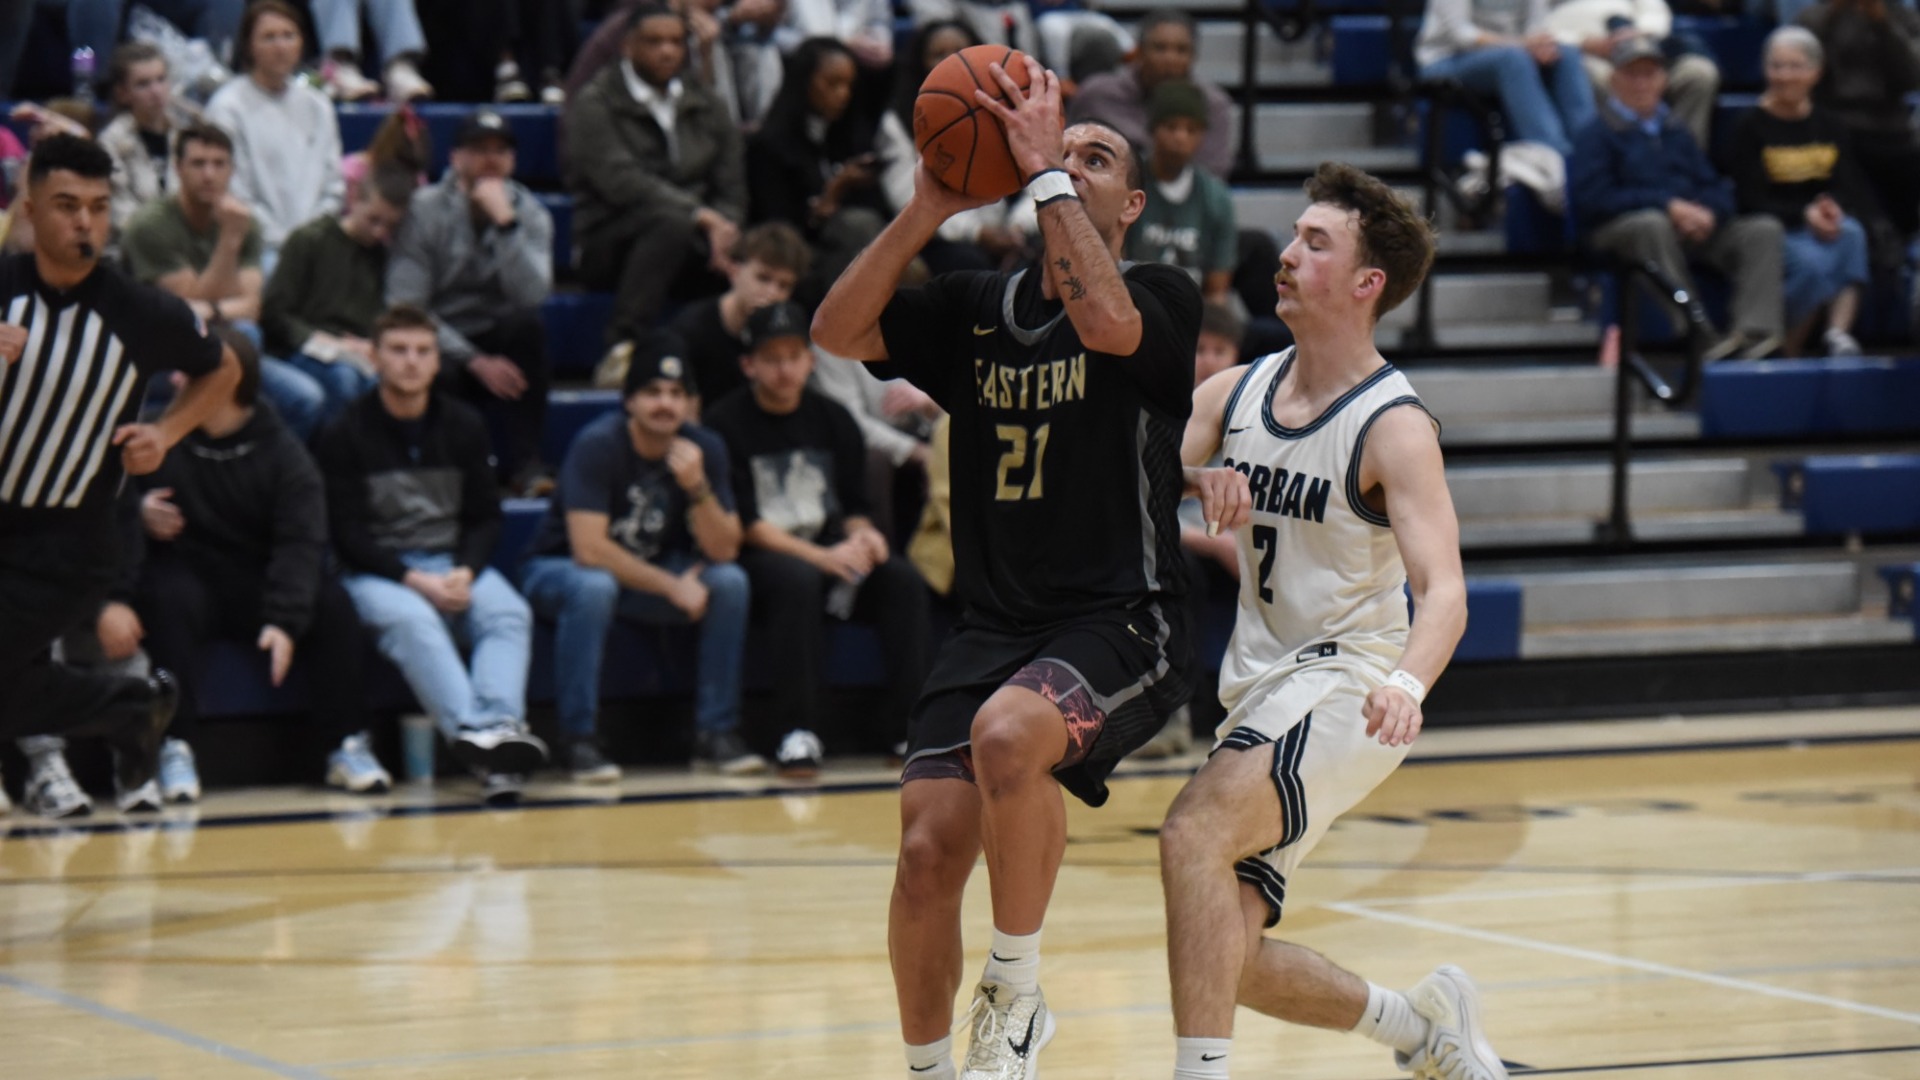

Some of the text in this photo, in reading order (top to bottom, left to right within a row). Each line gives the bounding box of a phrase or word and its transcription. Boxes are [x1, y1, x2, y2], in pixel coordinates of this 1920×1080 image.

[975, 352, 1086, 410] EASTERN
[995, 422, 1051, 501] 21
[1224, 457, 1332, 524] RBAN
[1253, 524, 1277, 604] 2
